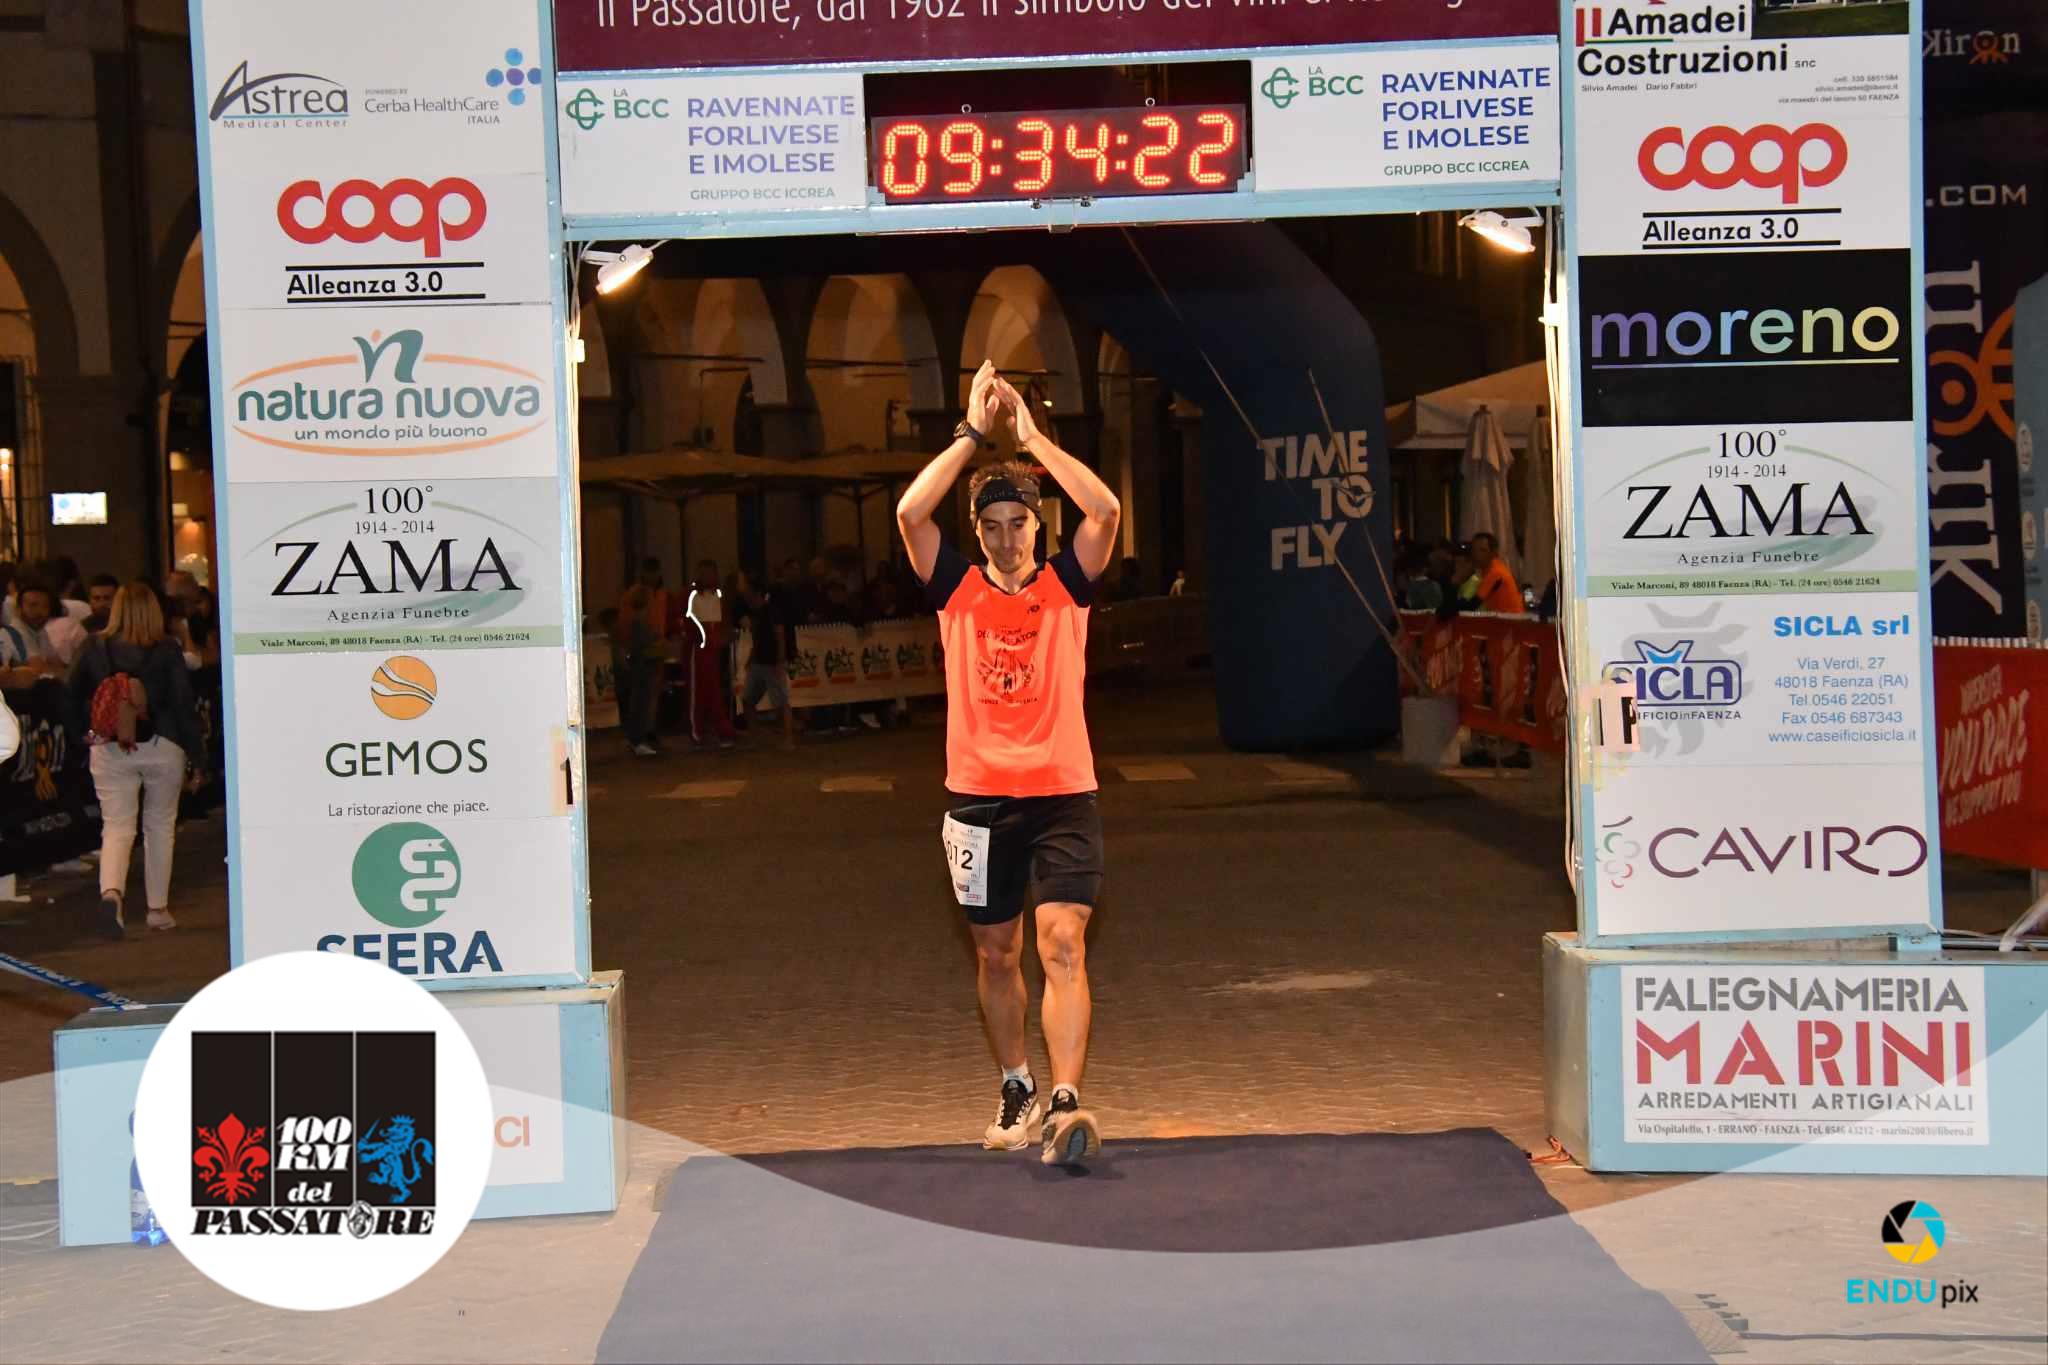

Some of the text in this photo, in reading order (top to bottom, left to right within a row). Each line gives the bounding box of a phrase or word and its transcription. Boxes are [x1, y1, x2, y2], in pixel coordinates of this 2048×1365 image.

[599, 0, 614, 26] Il
[633, 0, 800, 30] Passatore,
[1608, 4, 1745, 35] Amadei
[1308, 66, 1322, 74] LA
[1577, 44, 1816, 76] Costruzioni snc
[210, 60, 348, 120] Astrea
[1308, 75, 1364, 96] BCC
[1382, 67, 1550, 94] RAVENNATE
[1582, 84, 1638, 92] Silvio Amadei
[614, 88, 628, 96] LA
[365, 97, 498, 112] Cerba HealthCare
[614, 98, 670, 118] BCC
[688, 96, 856, 118] RAVENNATE
[1383, 96, 1534, 122] FORLIVESE
[224, 119, 347, 128] Medical Center
[468, 115, 500, 125] ITALIA
[688, 124, 839, 146] FORLIVESE
[1384, 126, 1530, 150] E IMOLESE
[690, 152, 835, 174] E IMOLESE
[883, 112, 1234, 195] 09:34:22
[1638, 122, 1848, 204] coop
[1384, 160, 1530, 176] GRUPPO BCC ICCREA
[690, 187, 835, 200] GRUPPO BCC ICCREA
[278, 177, 487, 258] coop
[1644, 218, 1800, 242] Alleanza 3.0
[288, 272, 443, 294] Alleanza 3.0
[1592, 306, 1899, 358] moreno
[239, 383, 540, 422] natura nuova
[295, 424, 488, 441] un mondo più buono
[1256, 430, 1368, 480] TIME
[1718, 430, 1787, 458] 100°
[1708, 464, 1786, 478] 1914 2014
[366, 485, 434, 514] 100°
[1312, 474, 1376, 520] TO
[1622, 481, 1874, 538] ZAMA
[356, 520, 434, 534] 1914 2014
[1271, 522, 1347, 570] FLY
[271, 537, 522, 596] ZAMA
[1678, 551, 1819, 566] Agenzia Funebre
[1611, 582, 1634, 590] Viale
[1752, 579, 1772, 588] (RA)
[328, 606, 470, 623] Agenzia Funebre
[1774, 615, 1909, 636] SICLA srl
[260, 638, 285, 648] Viale
[403, 635, 423, 645] (RA)
[1798, 656, 1886, 670] Via Verdi, 27
[1775, 674, 1908, 689] 48018 Faenza (RA)
[1812, 693, 1847, 706] 0546
[1852, 693, 1894, 705] 22051
[1782, 711, 1902, 724] Fax 0546 687343
[326, 738, 488, 778] GEMOS
[328, 800, 490, 817] La ristorazione che piace.
[1648, 824, 1928, 878] CAVIRO
[1636, 977, 1968, 1012] FALEGNAMERIA
[1636, 1018, 1972, 1086] MARINI
[1638, 1092, 1973, 1112] ARREDAMENTI ARTIGIANALI
[1638, 1124, 1652, 1134] Via
[1718, 1124, 1757, 1134] ERRANO
[1764, 1125, 1800, 1134] FAENZA
